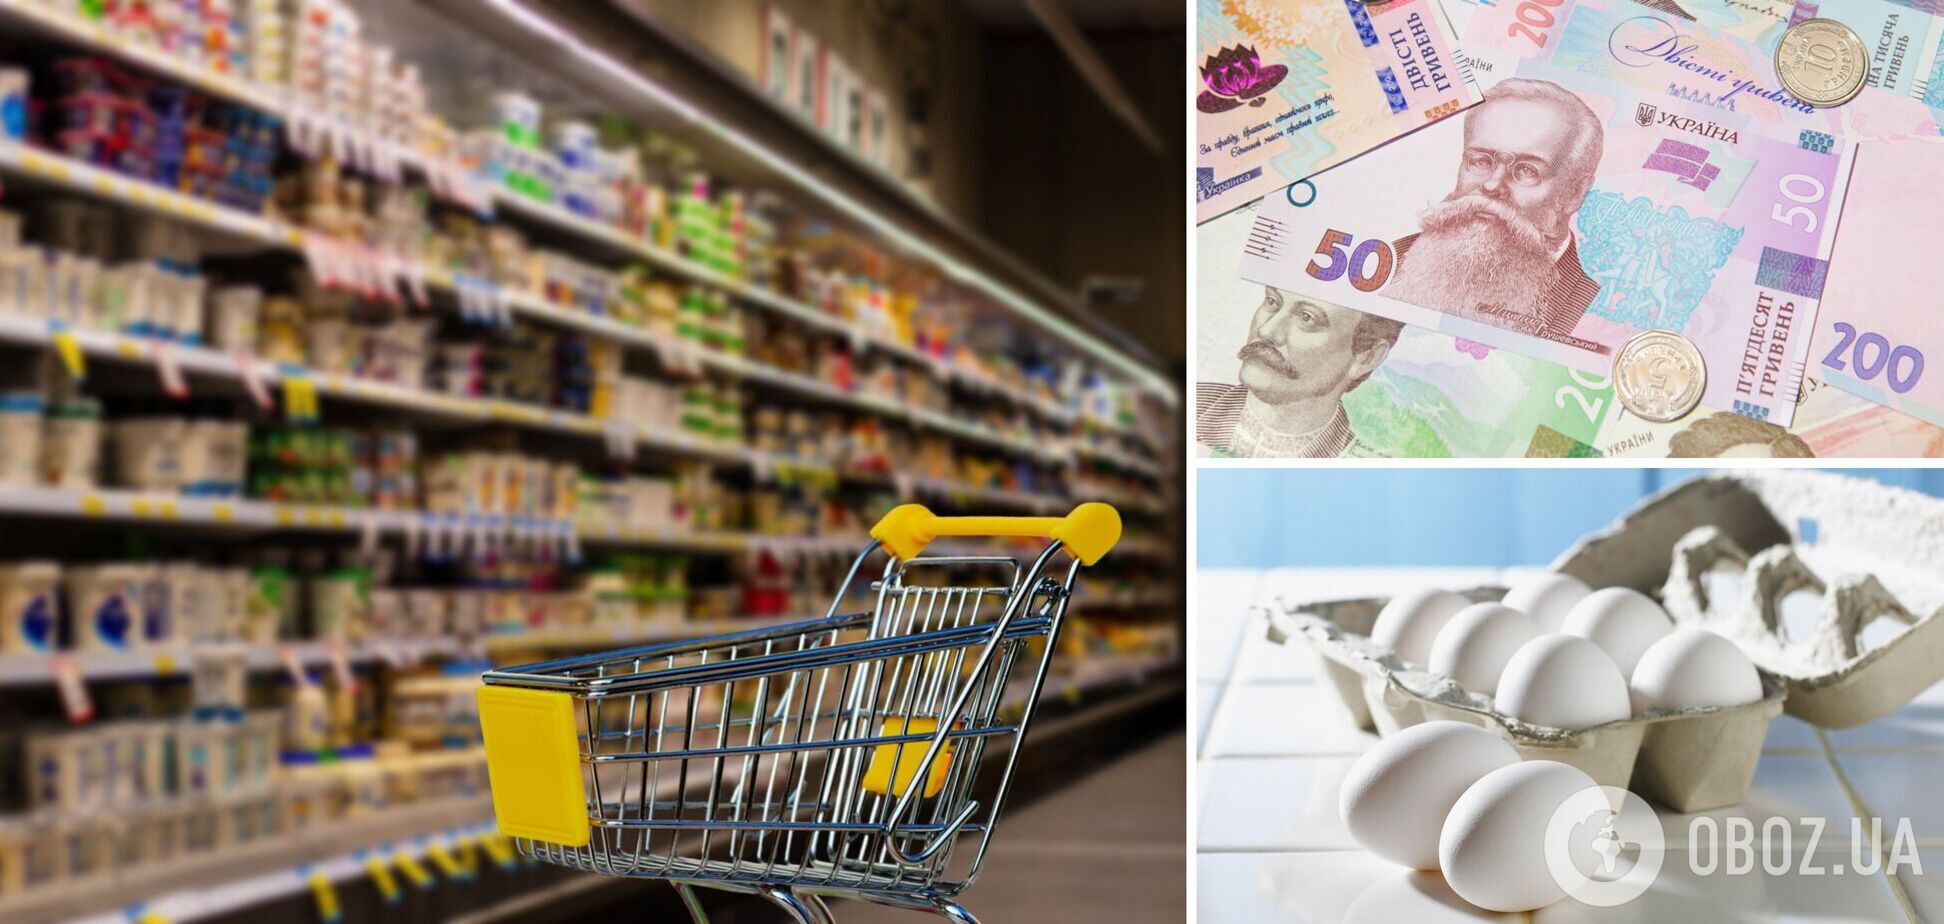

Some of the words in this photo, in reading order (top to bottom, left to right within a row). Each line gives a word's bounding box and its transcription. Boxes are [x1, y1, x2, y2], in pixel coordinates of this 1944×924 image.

[1407, 12, 1451, 93] ГРИВЕНЬ
[1508, 0, 1563, 48] 20
[1608, 16, 1729, 81] Двісті
[1875, 13, 1900, 65] ТИСЯЧА
[1389, 28, 1430, 91] ДВІСТІ
[1804, 43, 1837, 72] 10
[1883, 35, 1910, 90] ГРИВЕНЬ
[1657, 111, 1739, 145] УКРАЇНА
[1771, 173, 1826, 234] 50
[1305, 228, 1393, 292] 50
[1736, 291, 1774, 396] П'ЯТДЕСЯТ
[1760, 301, 1795, 397] ГРИВЕНЬ
[1821, 321, 1925, 394] 200
[1607, 431, 1654, 457] УКРАЇНИ
